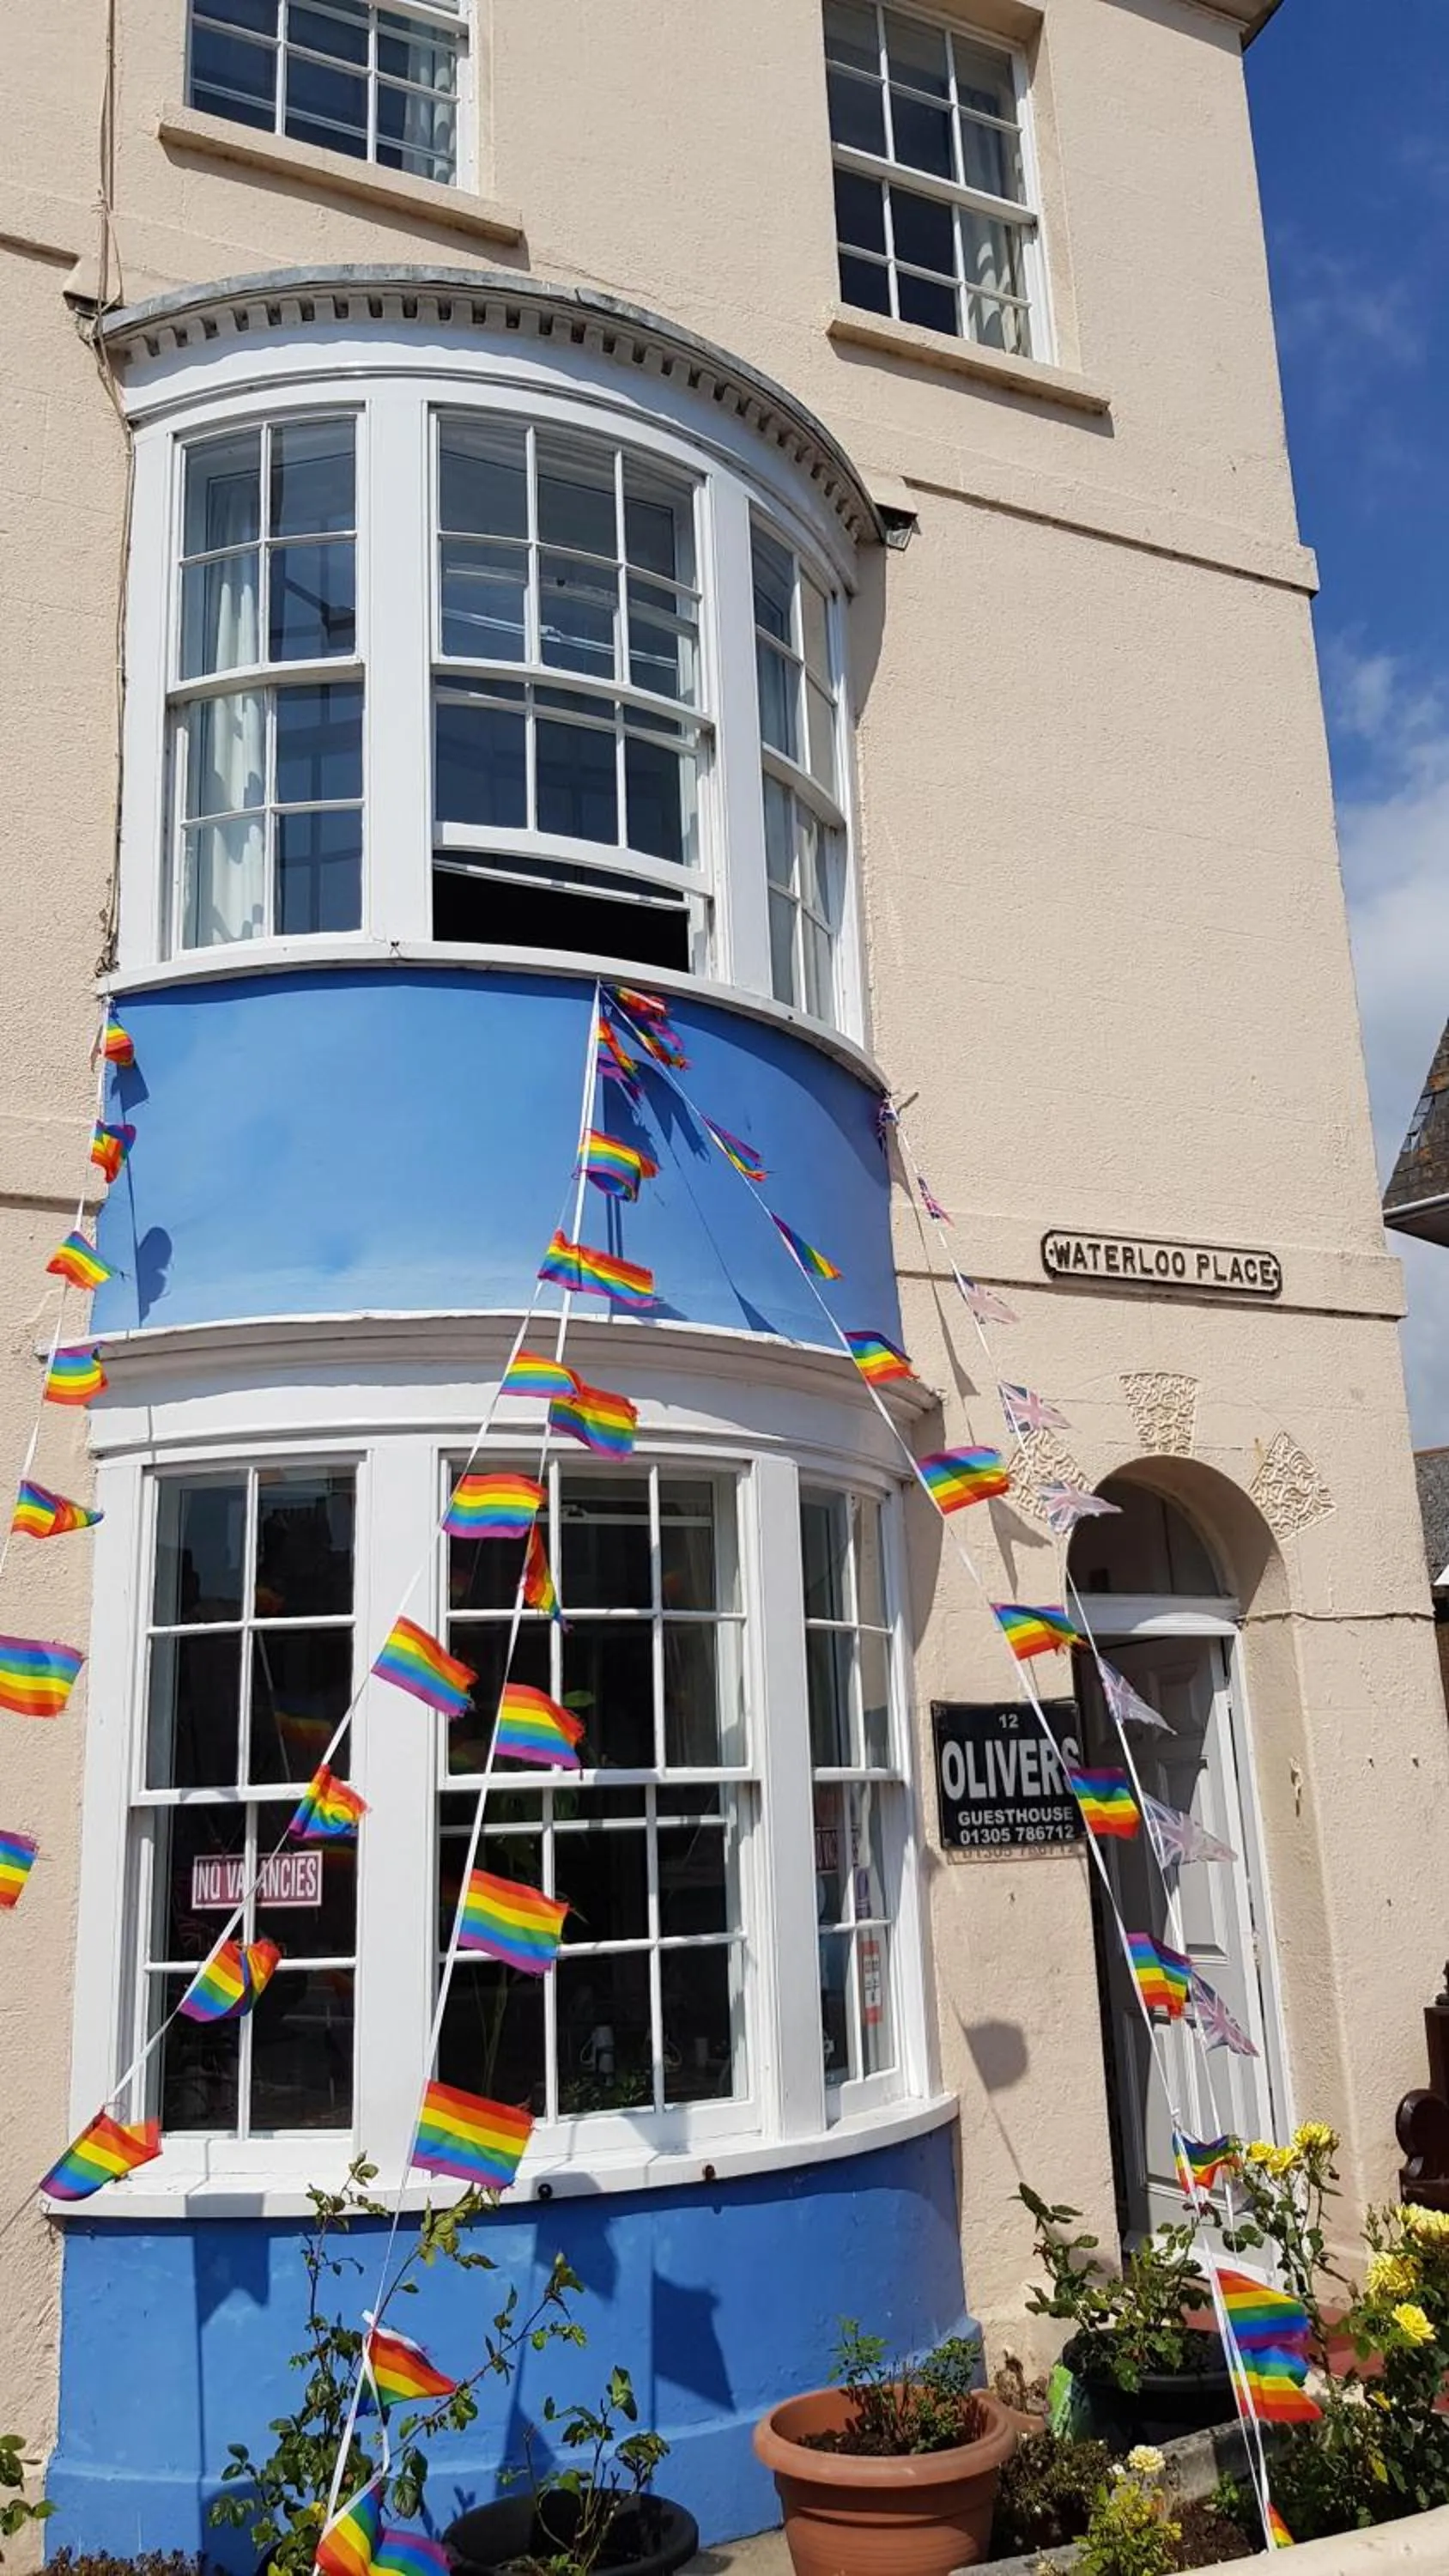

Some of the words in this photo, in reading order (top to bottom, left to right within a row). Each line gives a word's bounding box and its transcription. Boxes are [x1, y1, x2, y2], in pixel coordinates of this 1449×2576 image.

[1052, 1241, 1186, 1277] WATERLOO
[1196, 1253, 1276, 1285] PLACE
[998, 1713, 1020, 1728] 12
[942, 1737, 1081, 1801] OLIVERS
[957, 1806, 1074, 1826] GUESTHOUSE
[960, 1827, 1011, 1844] 01305
[1016, 1825, 1074, 1842] 786712
[197, 1862, 221, 1900] NO
[226, 1857, 317, 1899] VAANCIES
